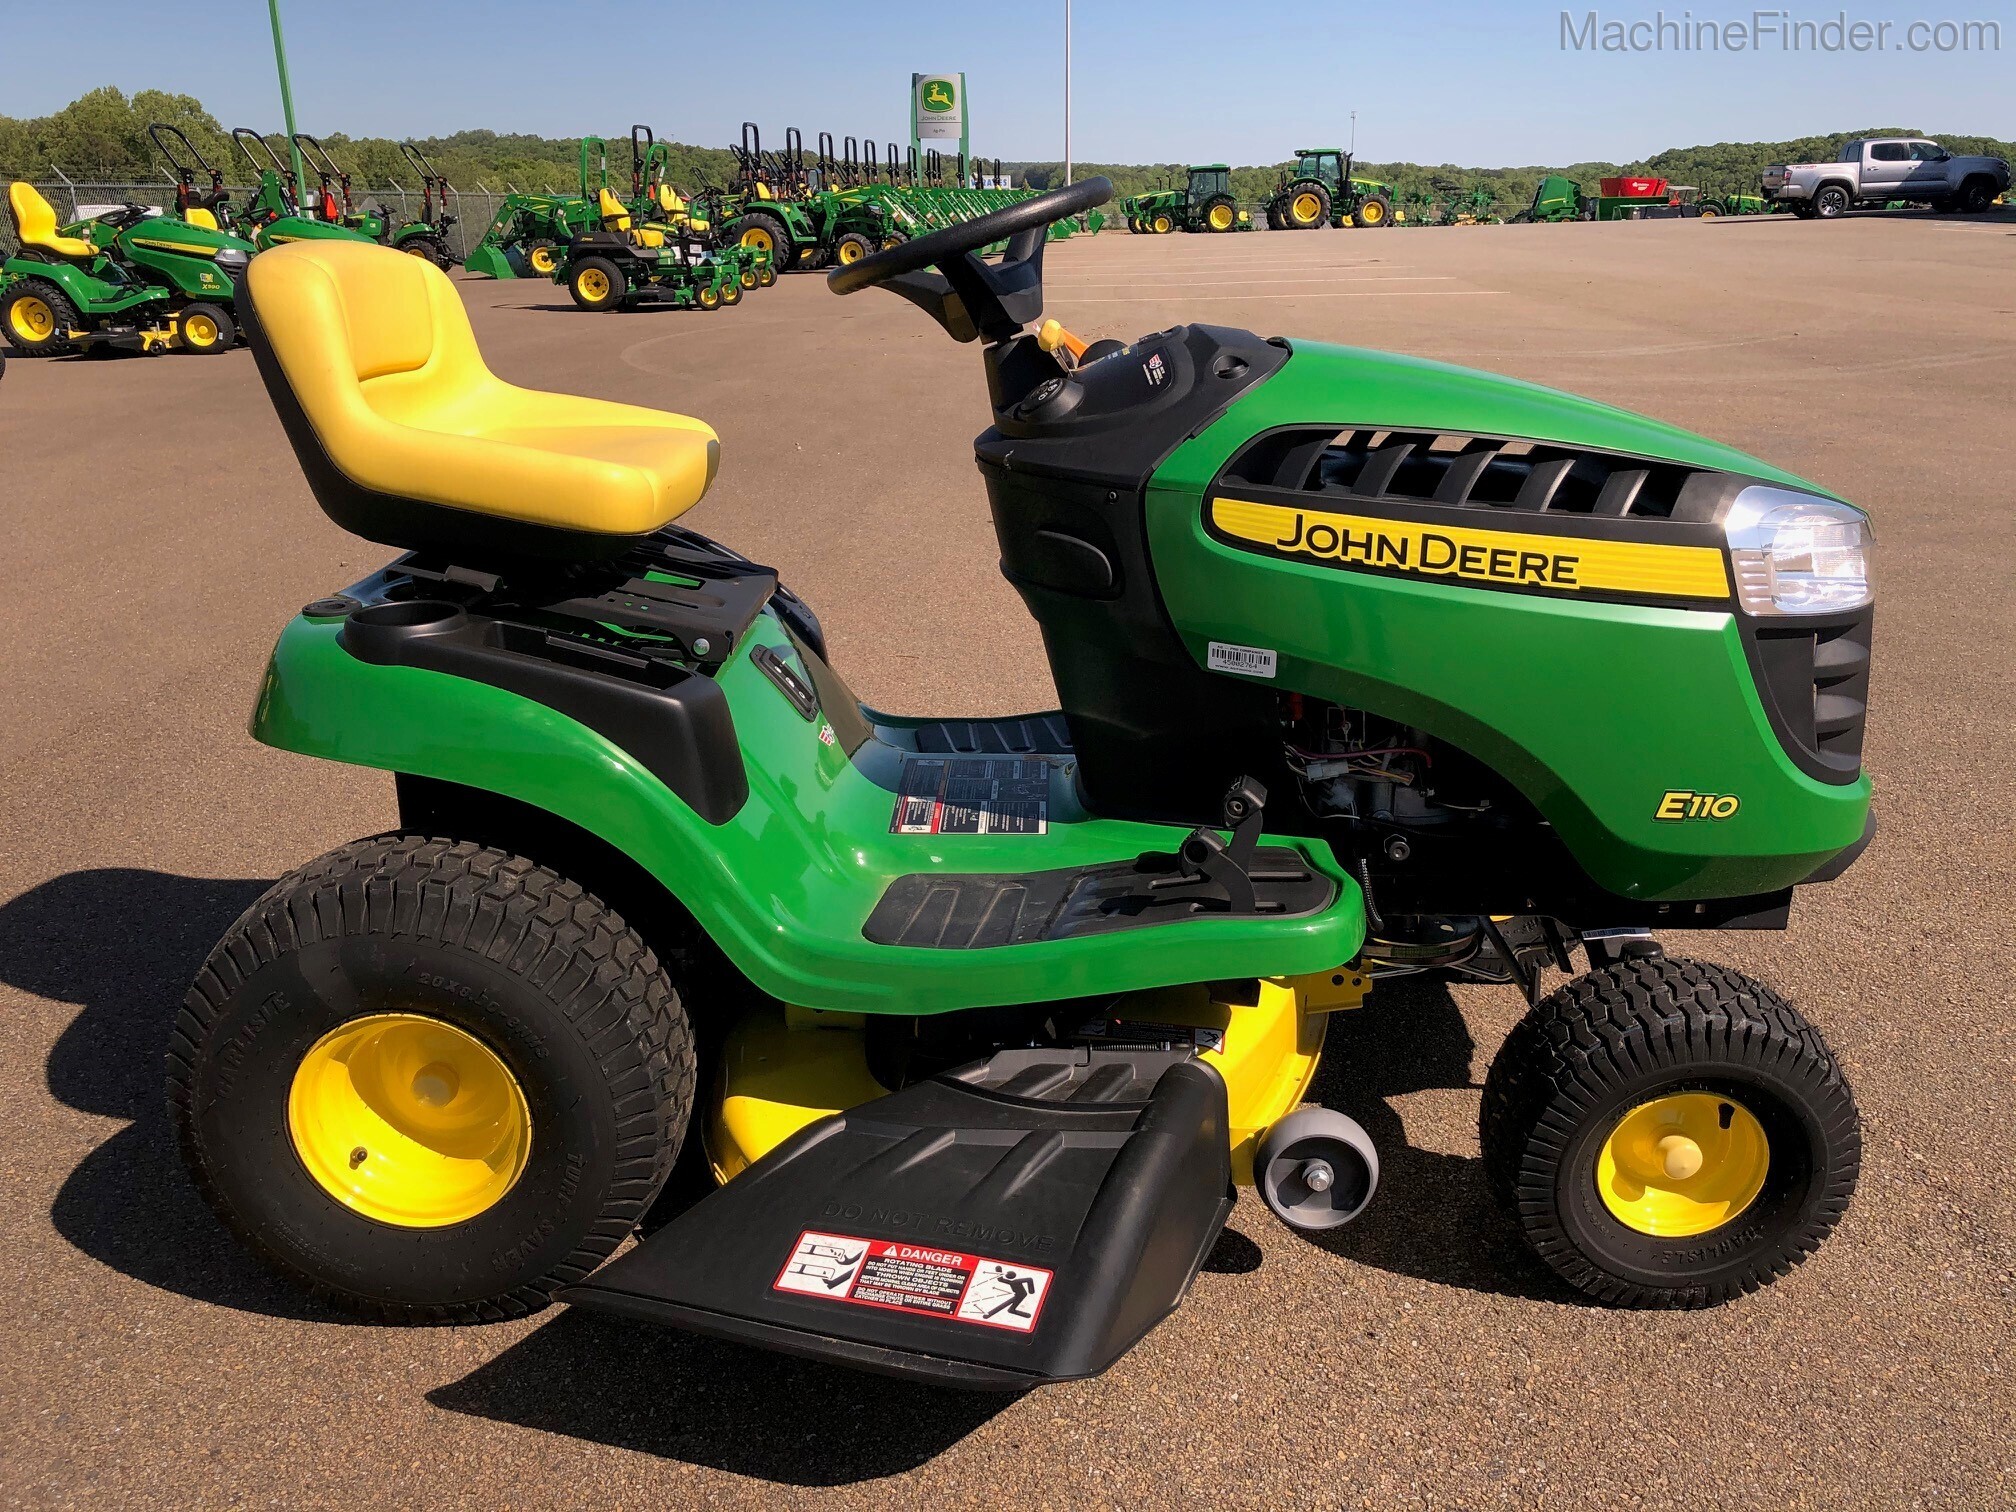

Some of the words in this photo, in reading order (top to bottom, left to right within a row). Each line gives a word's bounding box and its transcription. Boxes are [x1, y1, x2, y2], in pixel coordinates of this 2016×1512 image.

[1276, 513, 1408, 567] JOHN
[1419, 533, 1580, 585] DEERE
[1655, 790, 1739, 820] E110
[821, 1201, 863, 1219] DO
[869, 1207, 930, 1231] NOT
[932, 1214, 1057, 1253] REMOVE
[883, 1258, 924, 1269] ROTATING
[925, 1264, 953, 1273] BLADE
[900, 1247, 963, 1267] DANGER
[876, 1271, 910, 1281] THROWN
[912, 1277, 949, 1287] OBJECTS
